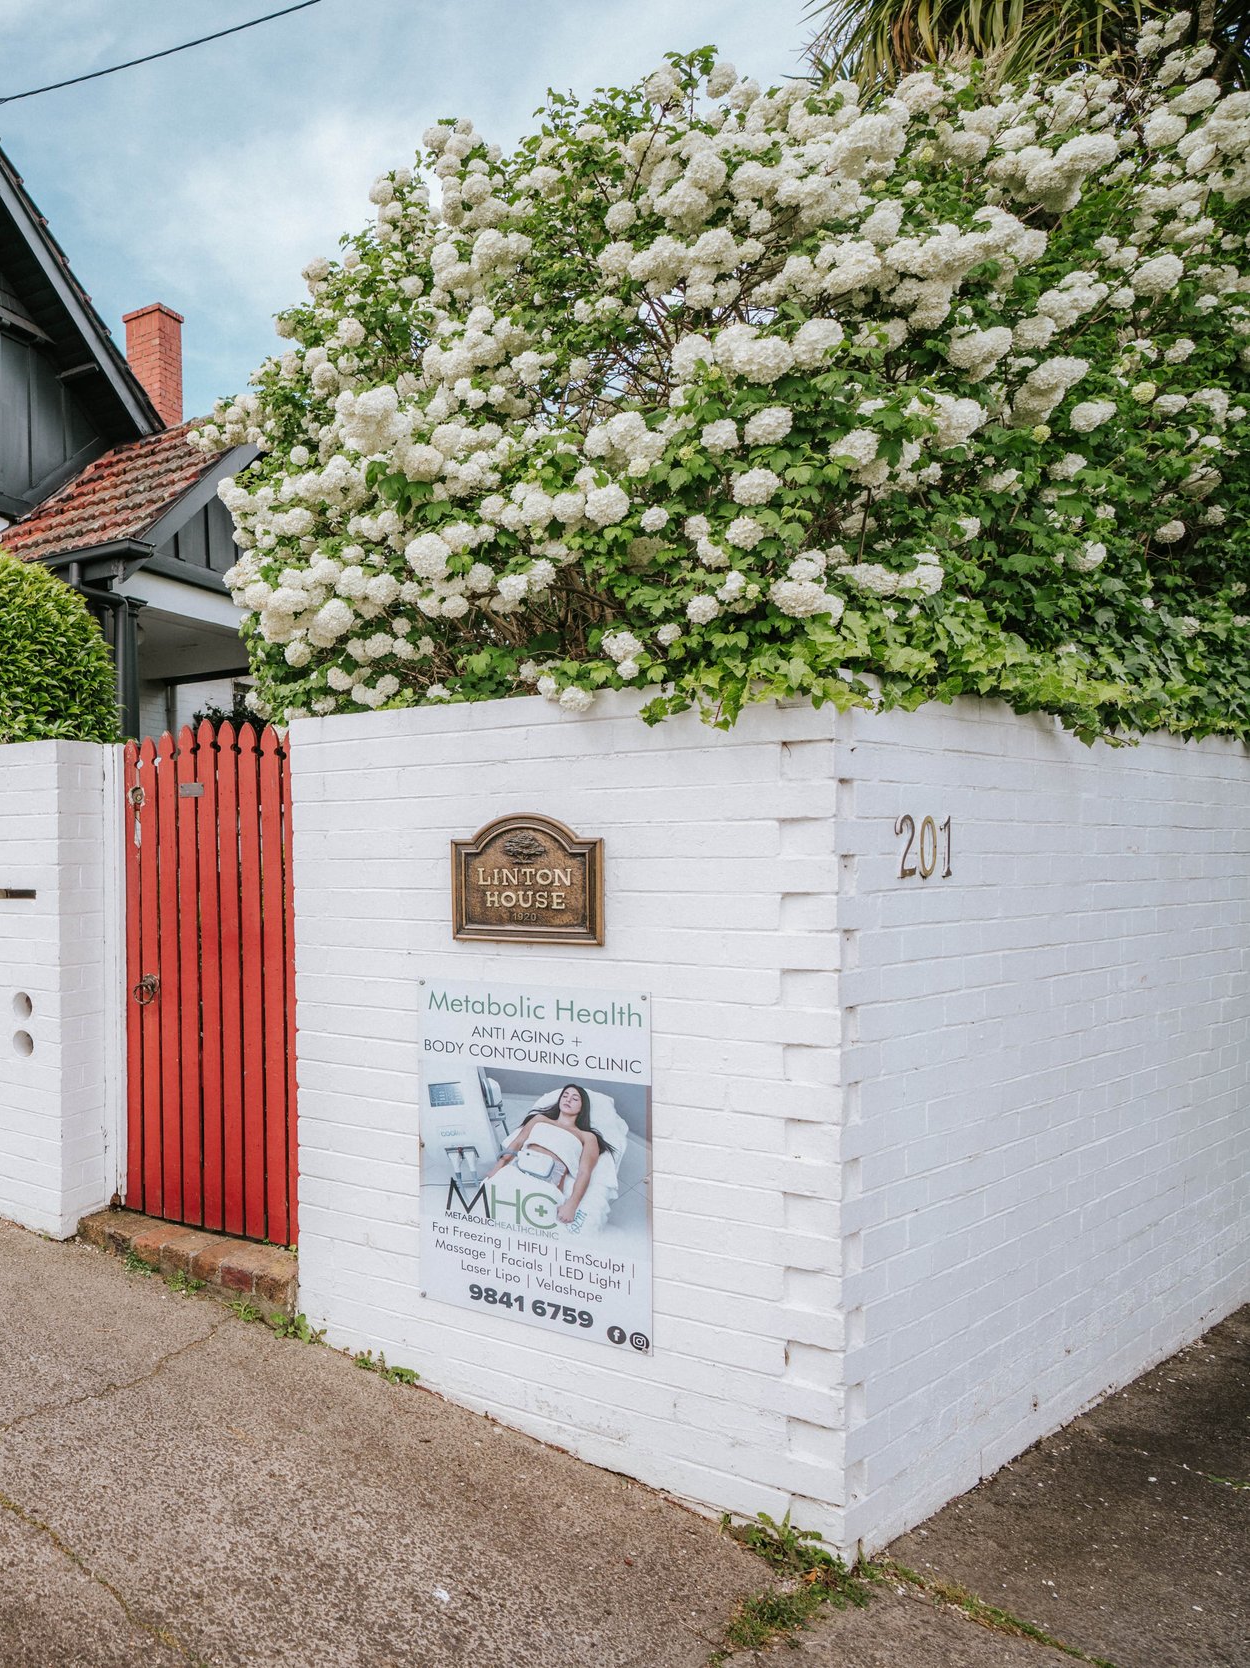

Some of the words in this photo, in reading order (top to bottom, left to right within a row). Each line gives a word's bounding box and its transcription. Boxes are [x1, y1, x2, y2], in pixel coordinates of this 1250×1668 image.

[894, 814, 953, 879] 201
[477, 867, 572, 886] LINTON
[485, 891, 566, 910] HOUSE
[512, 912, 537, 922] 1920
[428, 990, 545, 1020] Metabolic
[556, 999, 642, 1028] Health
[471, 1025, 505, 1041] ANTI
[510, 1029, 565, 1046] AGING
[424, 1039, 464, 1054] BODY
[469, 1043, 579, 1067] CONTOURING
[585, 1055, 642, 1074] CLINIC
[432, 1222, 449, 1235] Fat
[453, 1226, 502, 1249] Freezing
[517, 1240, 548, 1256] HIFU
[565, 1250, 625, 1274] EmSculpt
[435, 1239, 486, 1260] Massage
[501, 1253, 543, 1273] Facials
[559, 1265, 584, 1281] LED
[589, 1272, 621, 1290] Light
[461, 1260, 491, 1277] Laser
[495, 1268, 521, 1285] Lipo
[535, 1276, 603, 1304] Velashape
[469, 1283, 524, 1312] 9841
[531, 1300, 594, 1329] 6759
